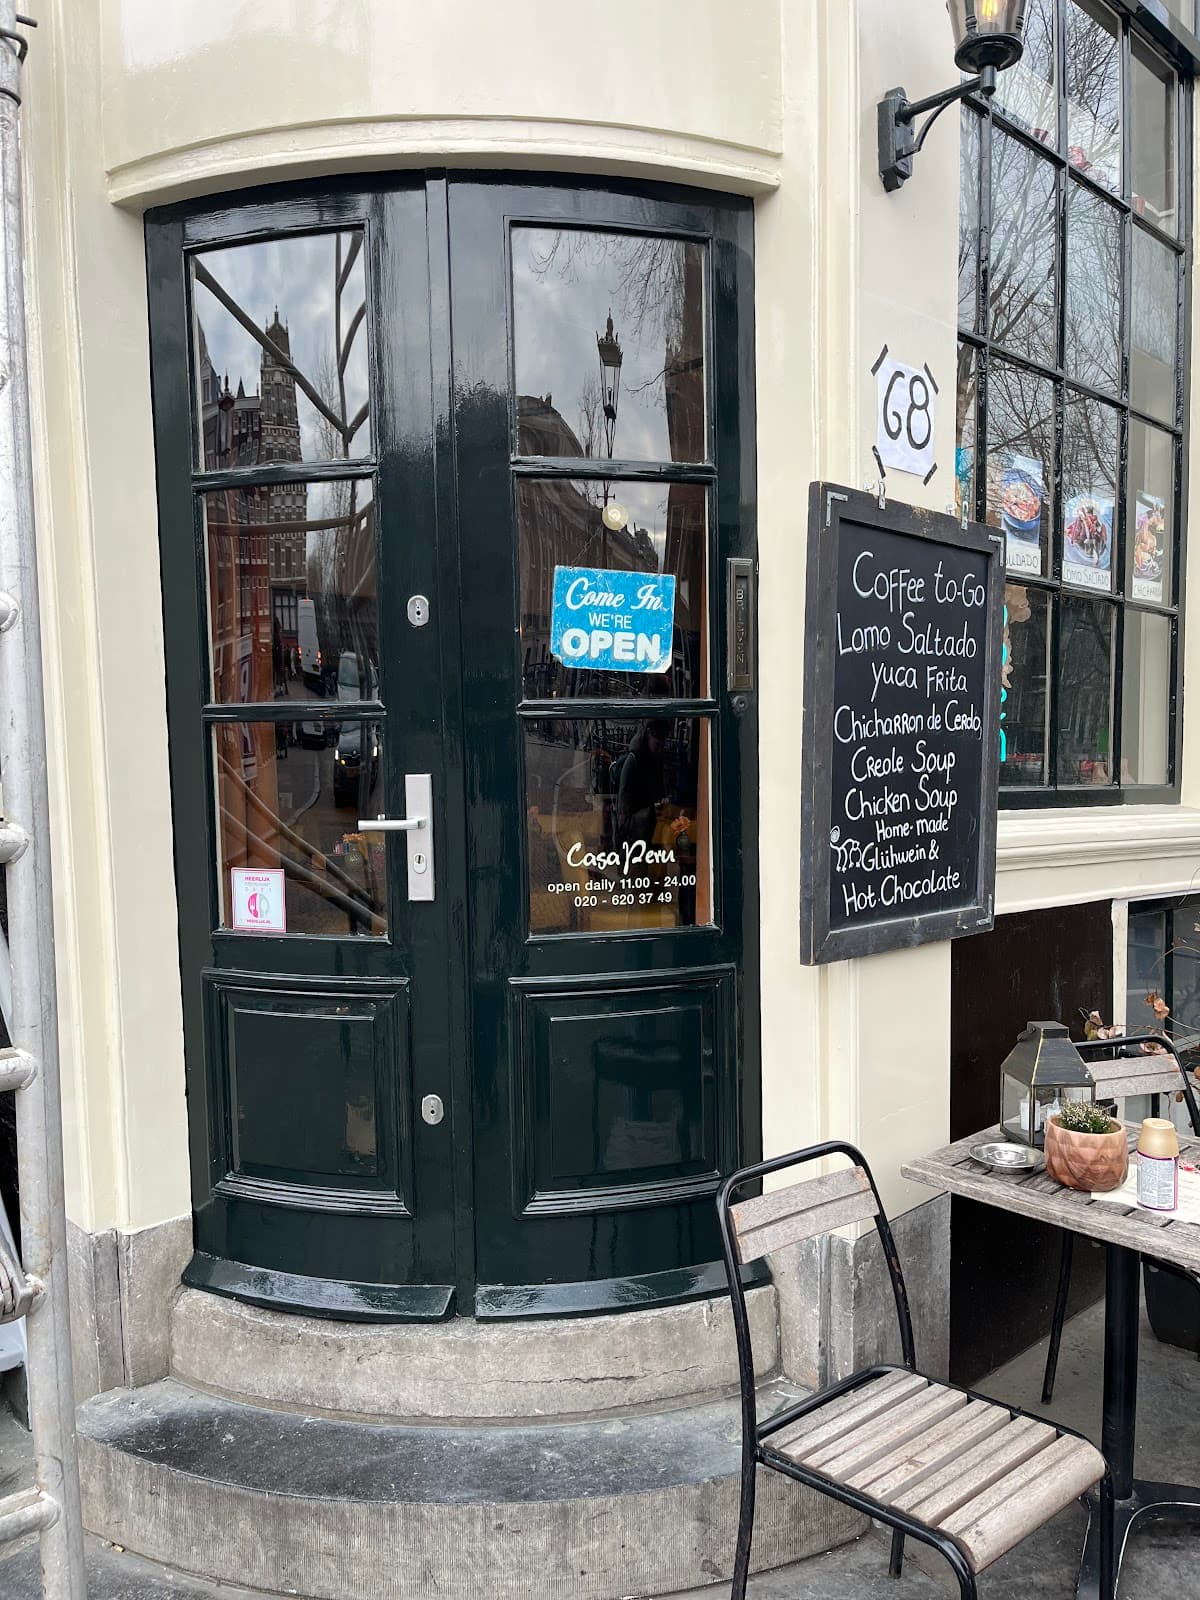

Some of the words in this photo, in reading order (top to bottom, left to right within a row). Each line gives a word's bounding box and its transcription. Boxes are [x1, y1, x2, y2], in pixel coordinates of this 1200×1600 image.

[882, 370, 932, 450] 68
[565, 577, 626, 611] Come
[631, 584, 670, 611] In
[588, 613, 633, 630] WE'RE
[837, 612, 892, 656] Lomo
[897, 611, 977, 658] Saltado
[562, 628, 662, 662] OPEN
[926, 703, 942, 732] de
[851, 746, 904, 782] Creole
[911, 739, 956, 784] Soup
[844, 785, 910, 821] Chicken
[915, 774, 958, 819] Soup
[916, 812, 949, 833] made
[566, 841, 621, 870] Casa
[622, 839, 676, 875] Peru
[928, 838, 940, 861] &
[547, 882, 581, 895] open
[584, 878, 616, 893] daily
[619, 876, 651, 890] 11.00
[663, 874, 697, 888] 24.00
[574, 896, 598, 908] 020
[611, 894, 635, 907] 620
[638, 892, 654, 905] 37
[657, 891, 674, 904] 49
